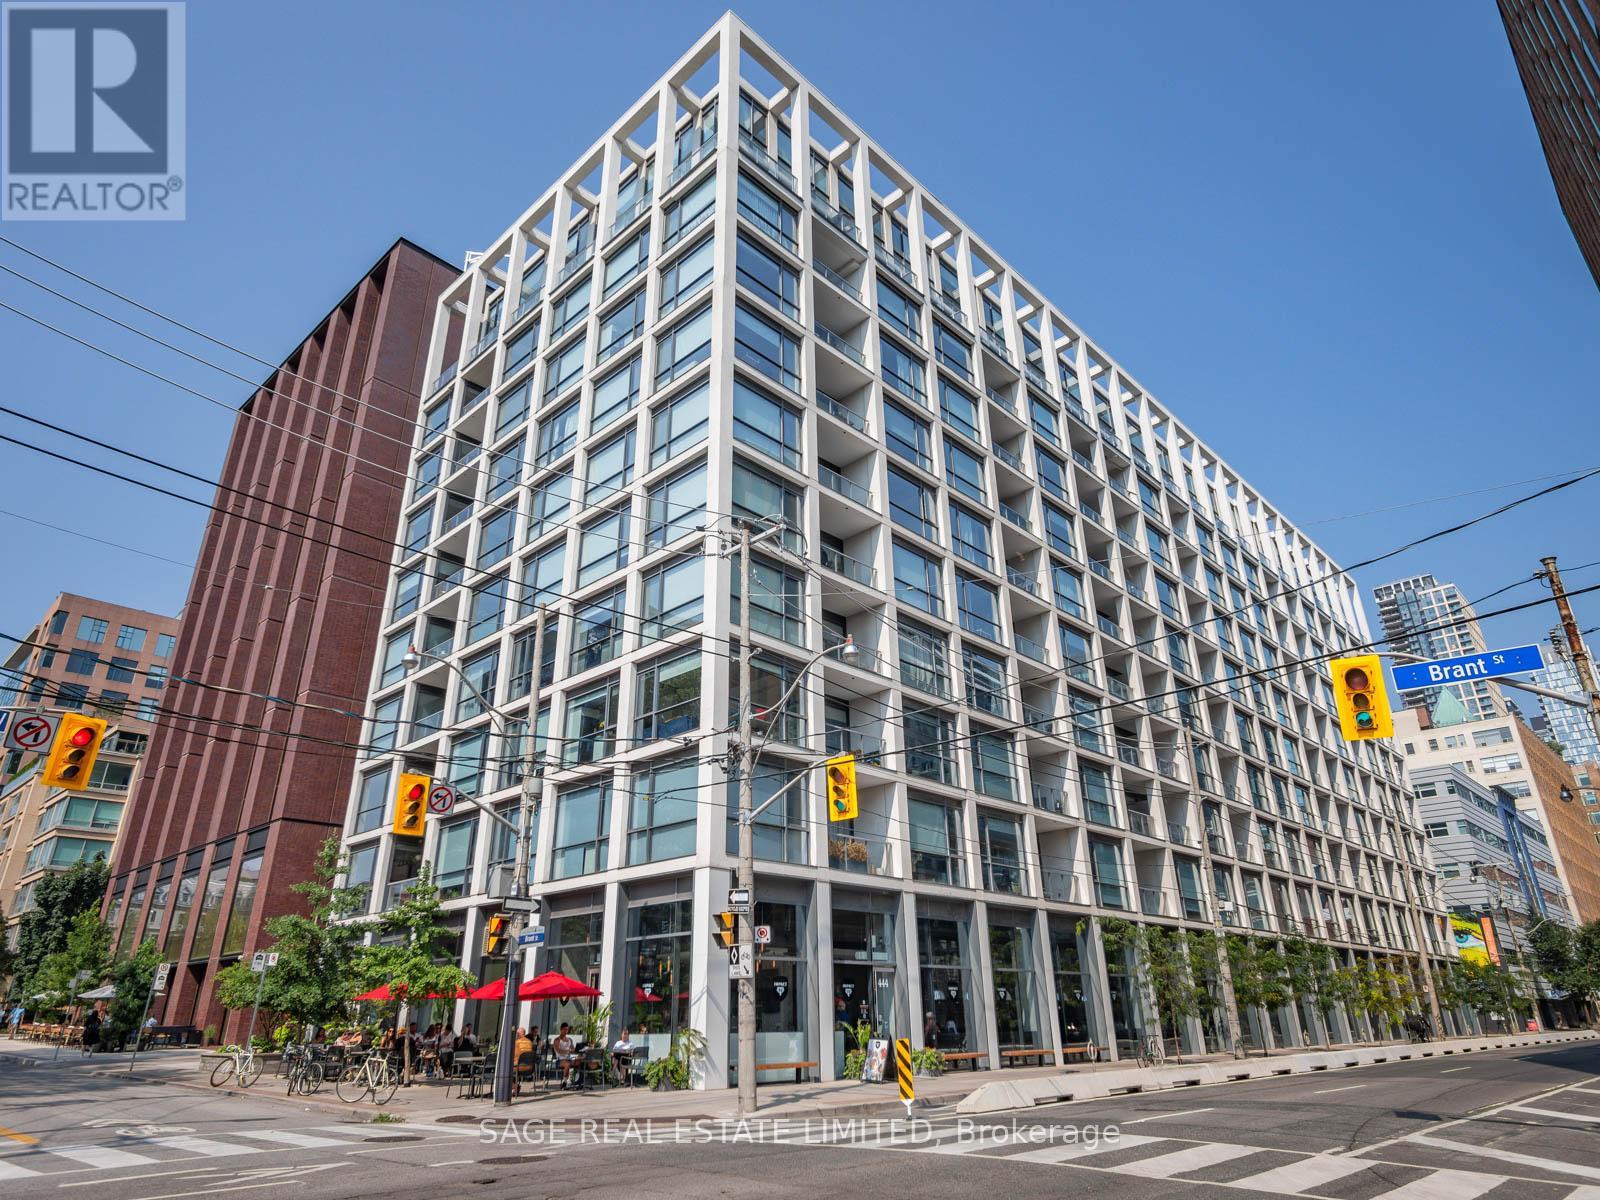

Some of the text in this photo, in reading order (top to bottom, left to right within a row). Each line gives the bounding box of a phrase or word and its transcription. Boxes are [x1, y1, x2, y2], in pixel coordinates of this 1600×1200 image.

[1428, 654, 1506, 682] Brant St
[878, 978, 889, 988] 444
